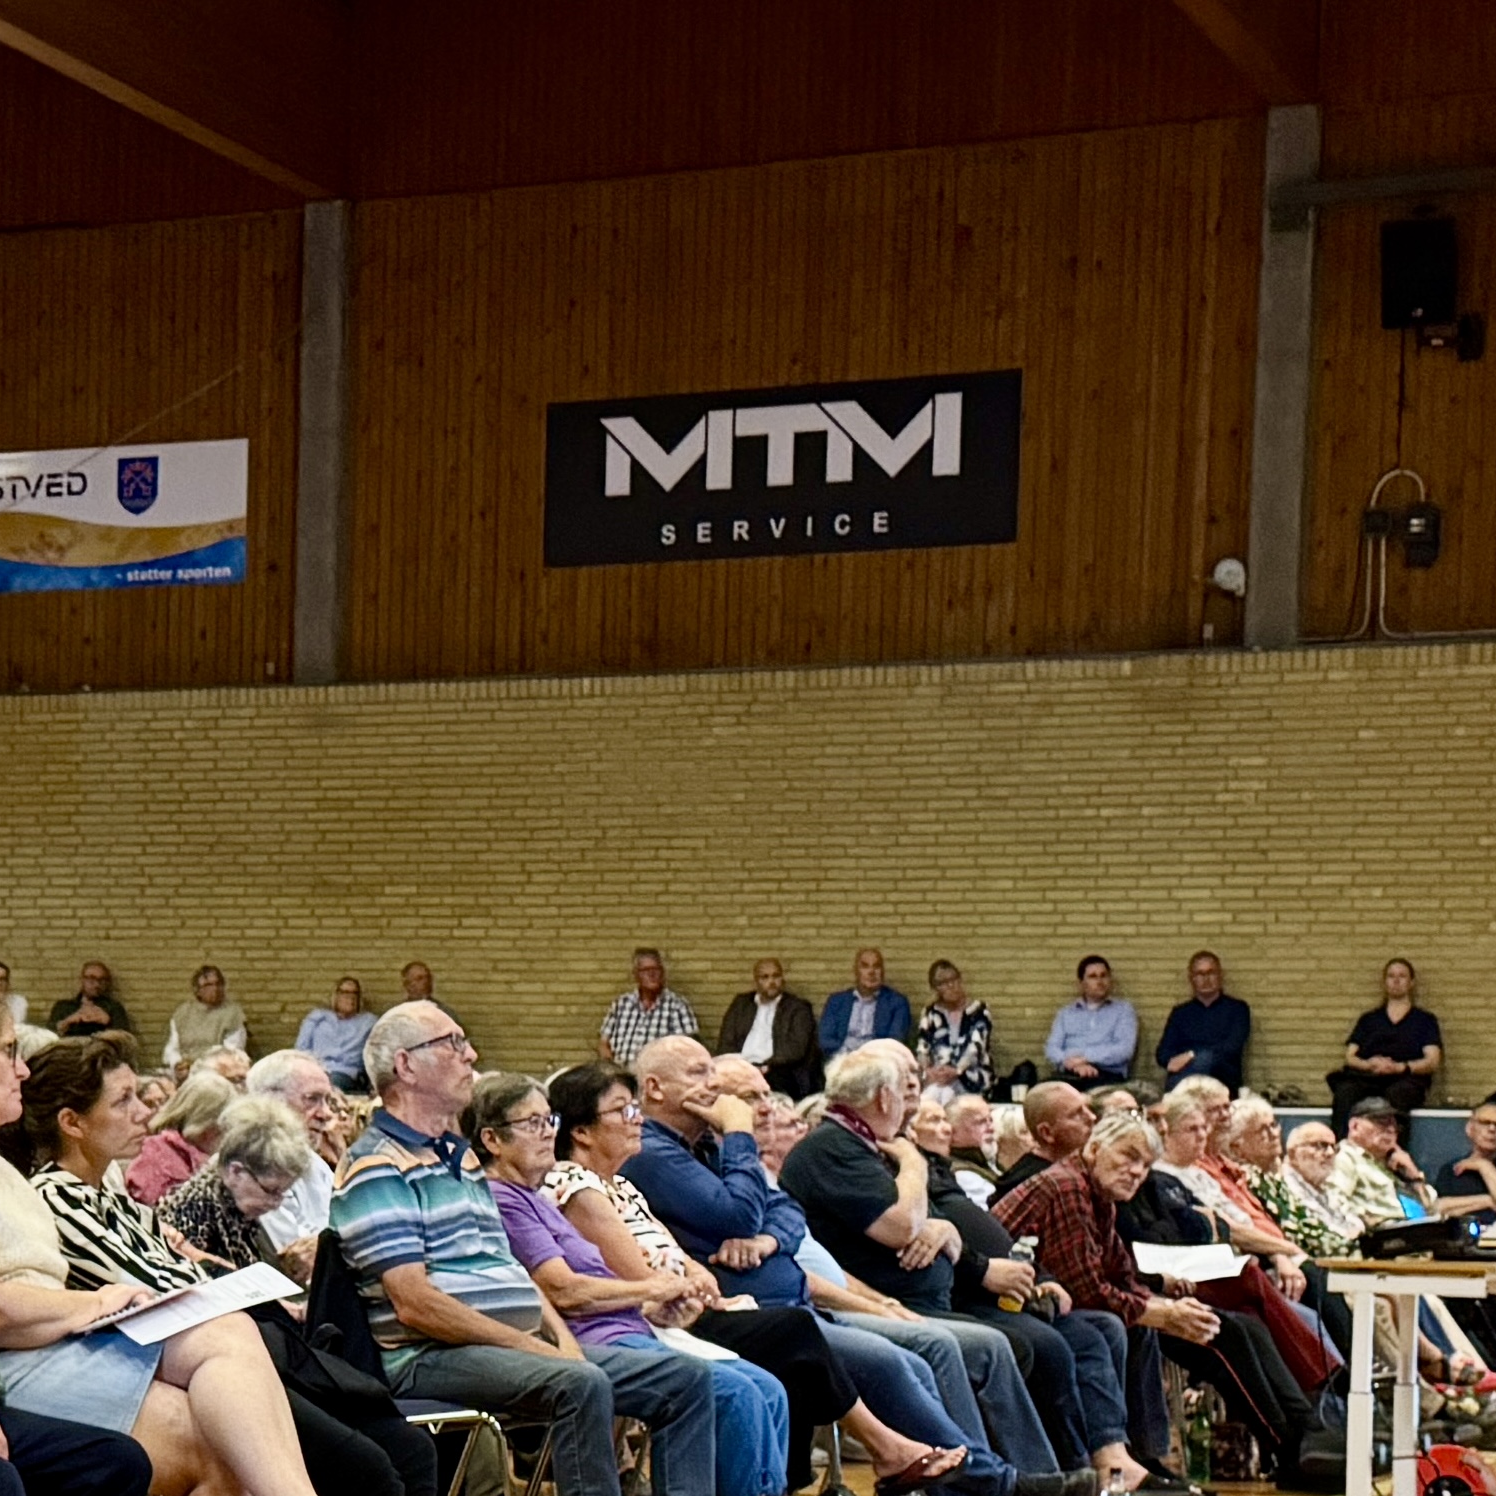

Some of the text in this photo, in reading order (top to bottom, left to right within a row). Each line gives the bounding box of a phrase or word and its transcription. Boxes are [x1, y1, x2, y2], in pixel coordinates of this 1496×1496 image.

[599, 391, 964, 498] MTM
[660, 510, 890, 546] SERVICE
[175, 565, 232, 583] sporten
